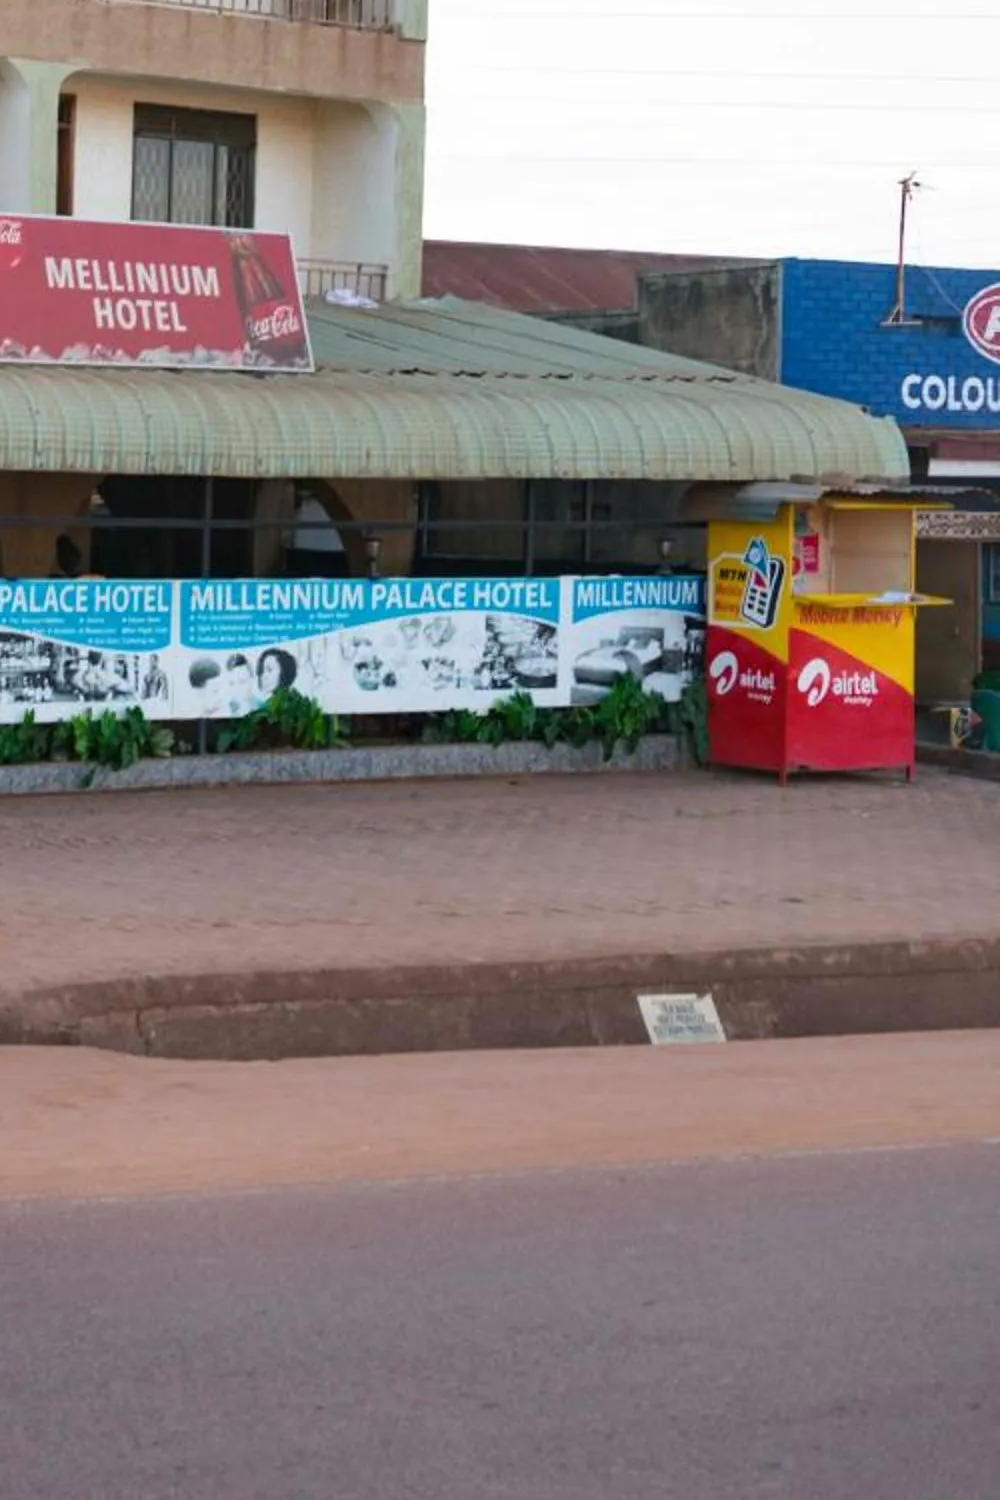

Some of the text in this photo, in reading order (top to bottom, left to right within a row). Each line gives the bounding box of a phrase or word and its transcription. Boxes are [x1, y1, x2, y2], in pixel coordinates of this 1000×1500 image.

[44, 256, 221, 298] MELLINIUM
[92, 298, 188, 333] HOTEL
[1, 583, 89, 613] PALACE
[94, 583, 169, 613] HOTEL
[190, 581, 553, 612] MILLENNIUM PALACE HOTEL
[577, 580, 699, 607] MILLENNIUM
[740, 668, 776, 691] airtel
[832, 670, 879, 695] airtel
